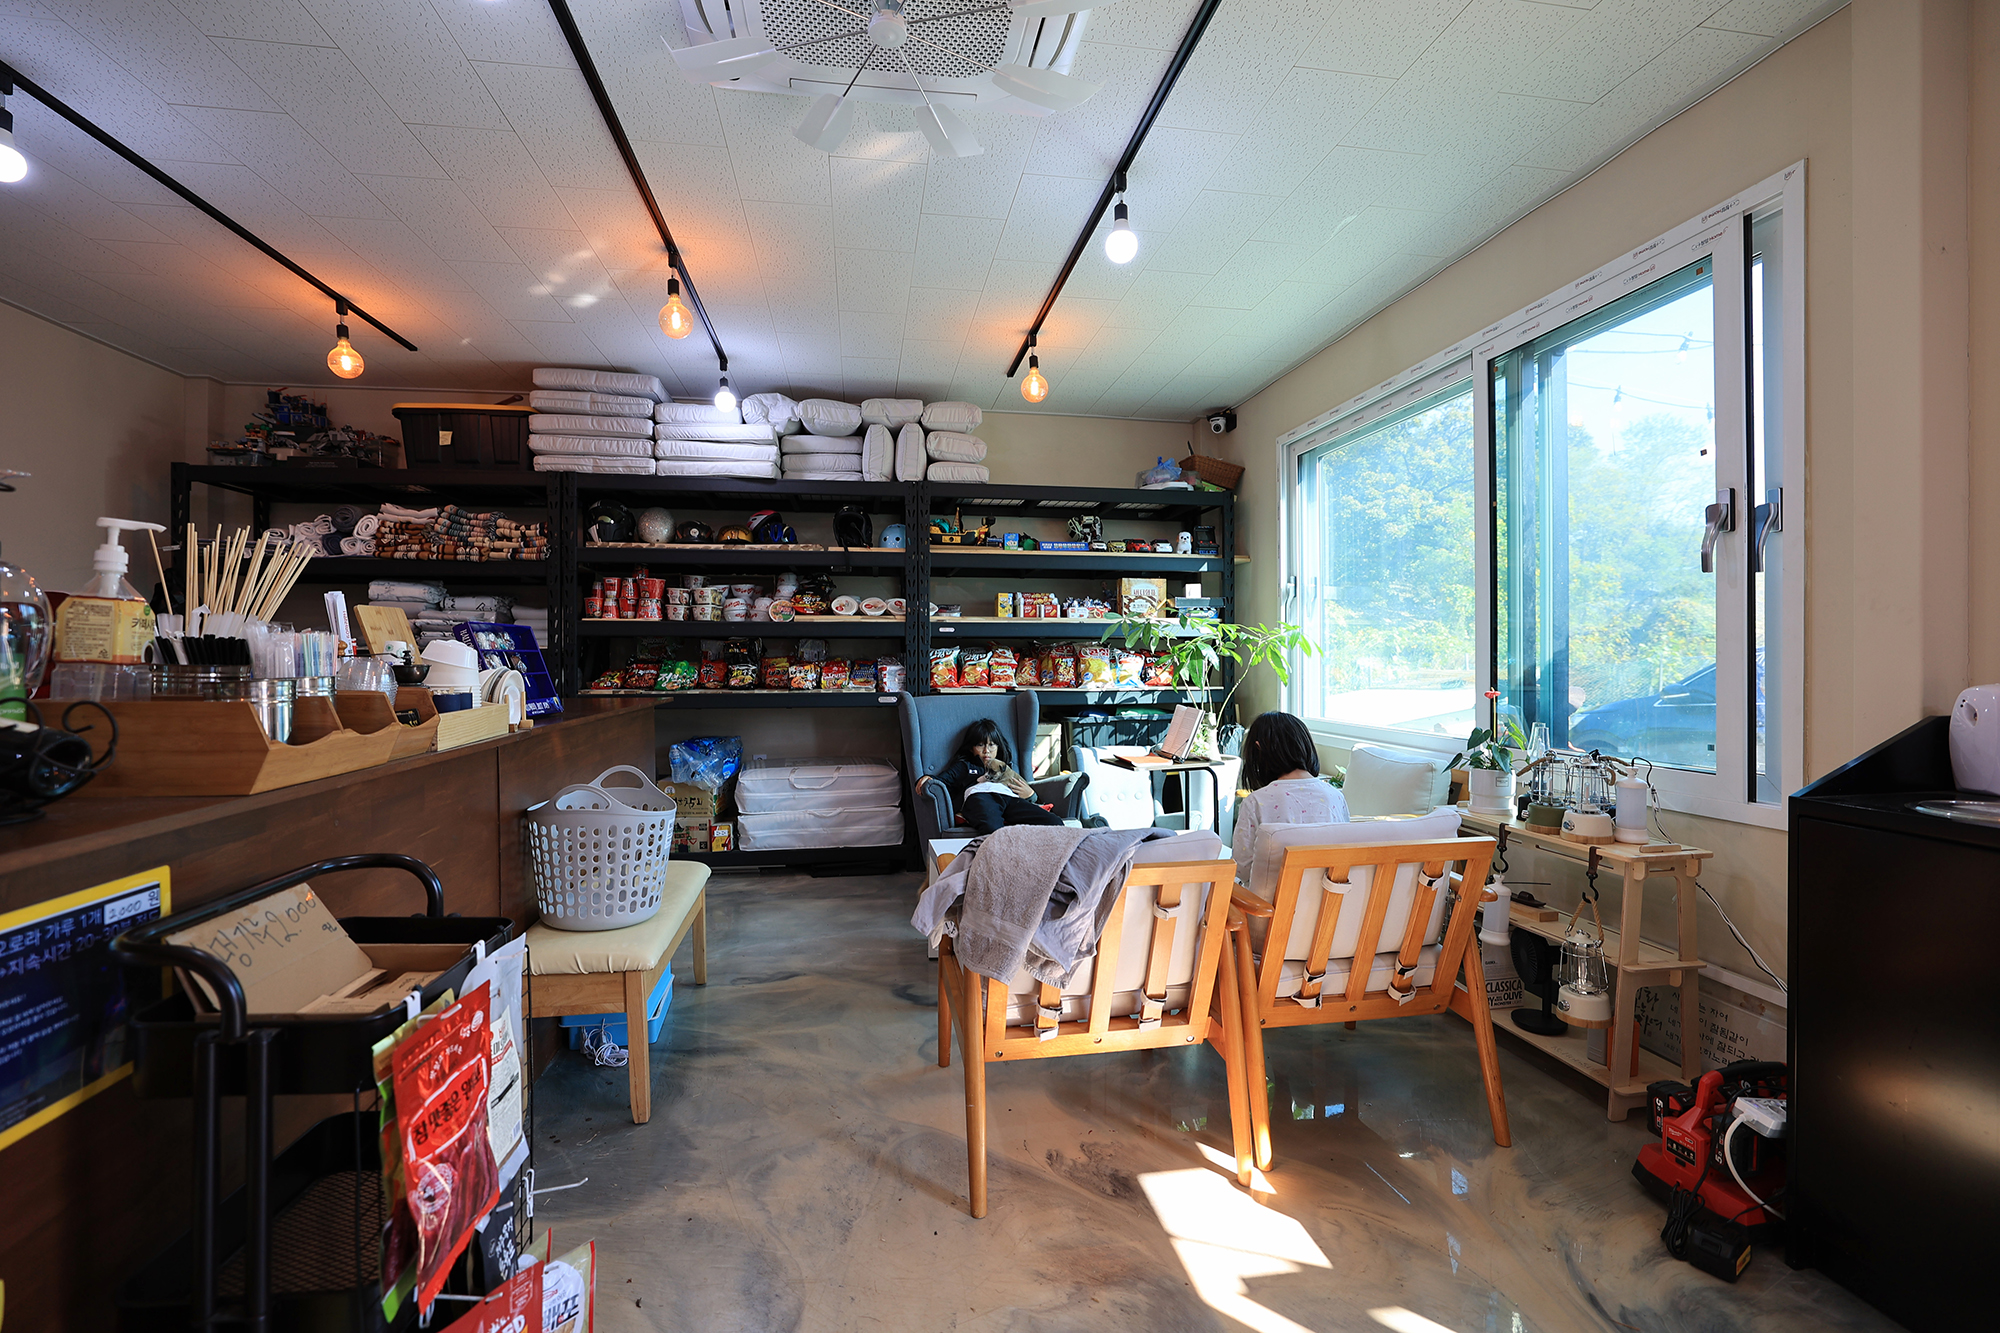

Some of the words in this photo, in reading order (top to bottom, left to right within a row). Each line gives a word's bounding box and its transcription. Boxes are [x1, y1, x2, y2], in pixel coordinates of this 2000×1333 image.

[701, 664, 717, 681] 辛
[45, 918, 76, 941] 가루
[81, 907, 103, 929] 1개
[148, 891, 161, 907] 원
[190, 917, 284, 967] 멍가루
[6, 943, 72, 976] 지속시간
[1504, 991, 1523, 1000] OLIVE
[1710, 1007, 1729, 1022] 자여
[1709, 1022, 1750, 1047] 잘됨같이
[1717, 1041, 1746, 1060] 잘되고
[411, 1122, 429, 1146] 참
